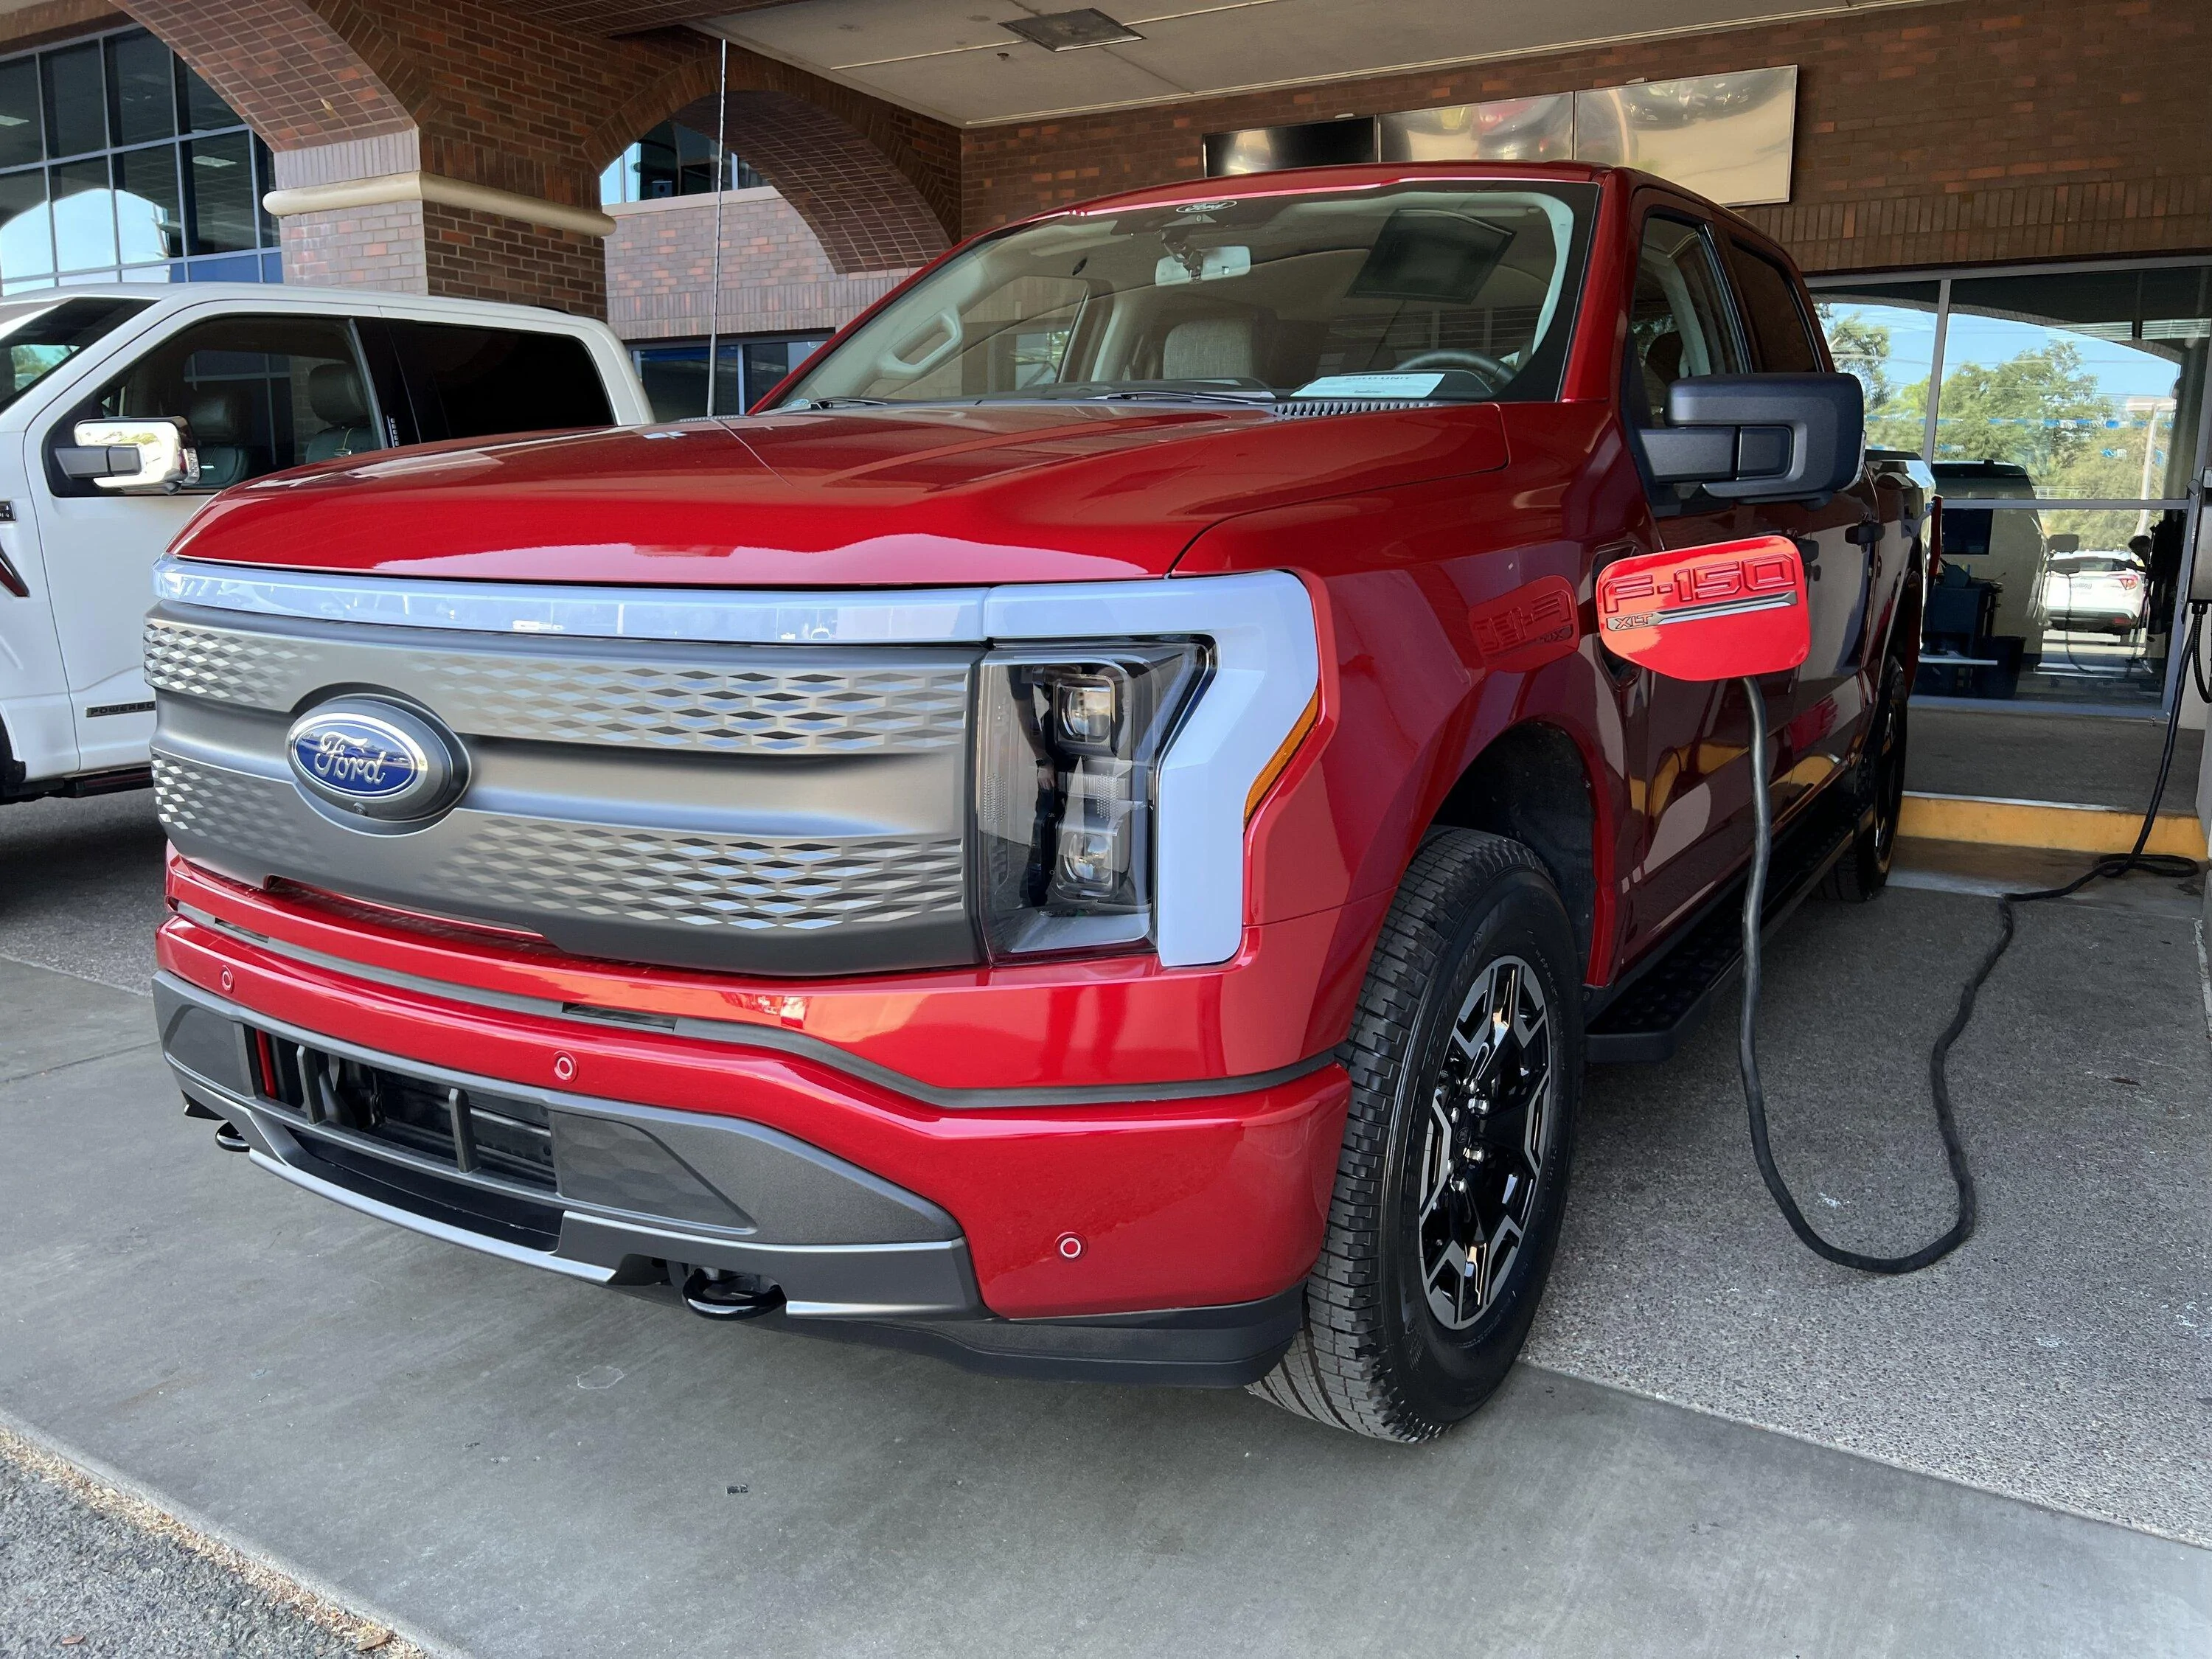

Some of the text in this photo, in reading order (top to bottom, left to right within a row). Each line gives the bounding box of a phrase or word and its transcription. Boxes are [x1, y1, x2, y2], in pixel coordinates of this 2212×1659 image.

[1602, 554, 1796, 613] F-150
[1615, 613, 1654, 630] XLT
[313, 731, 387, 786] Ford
